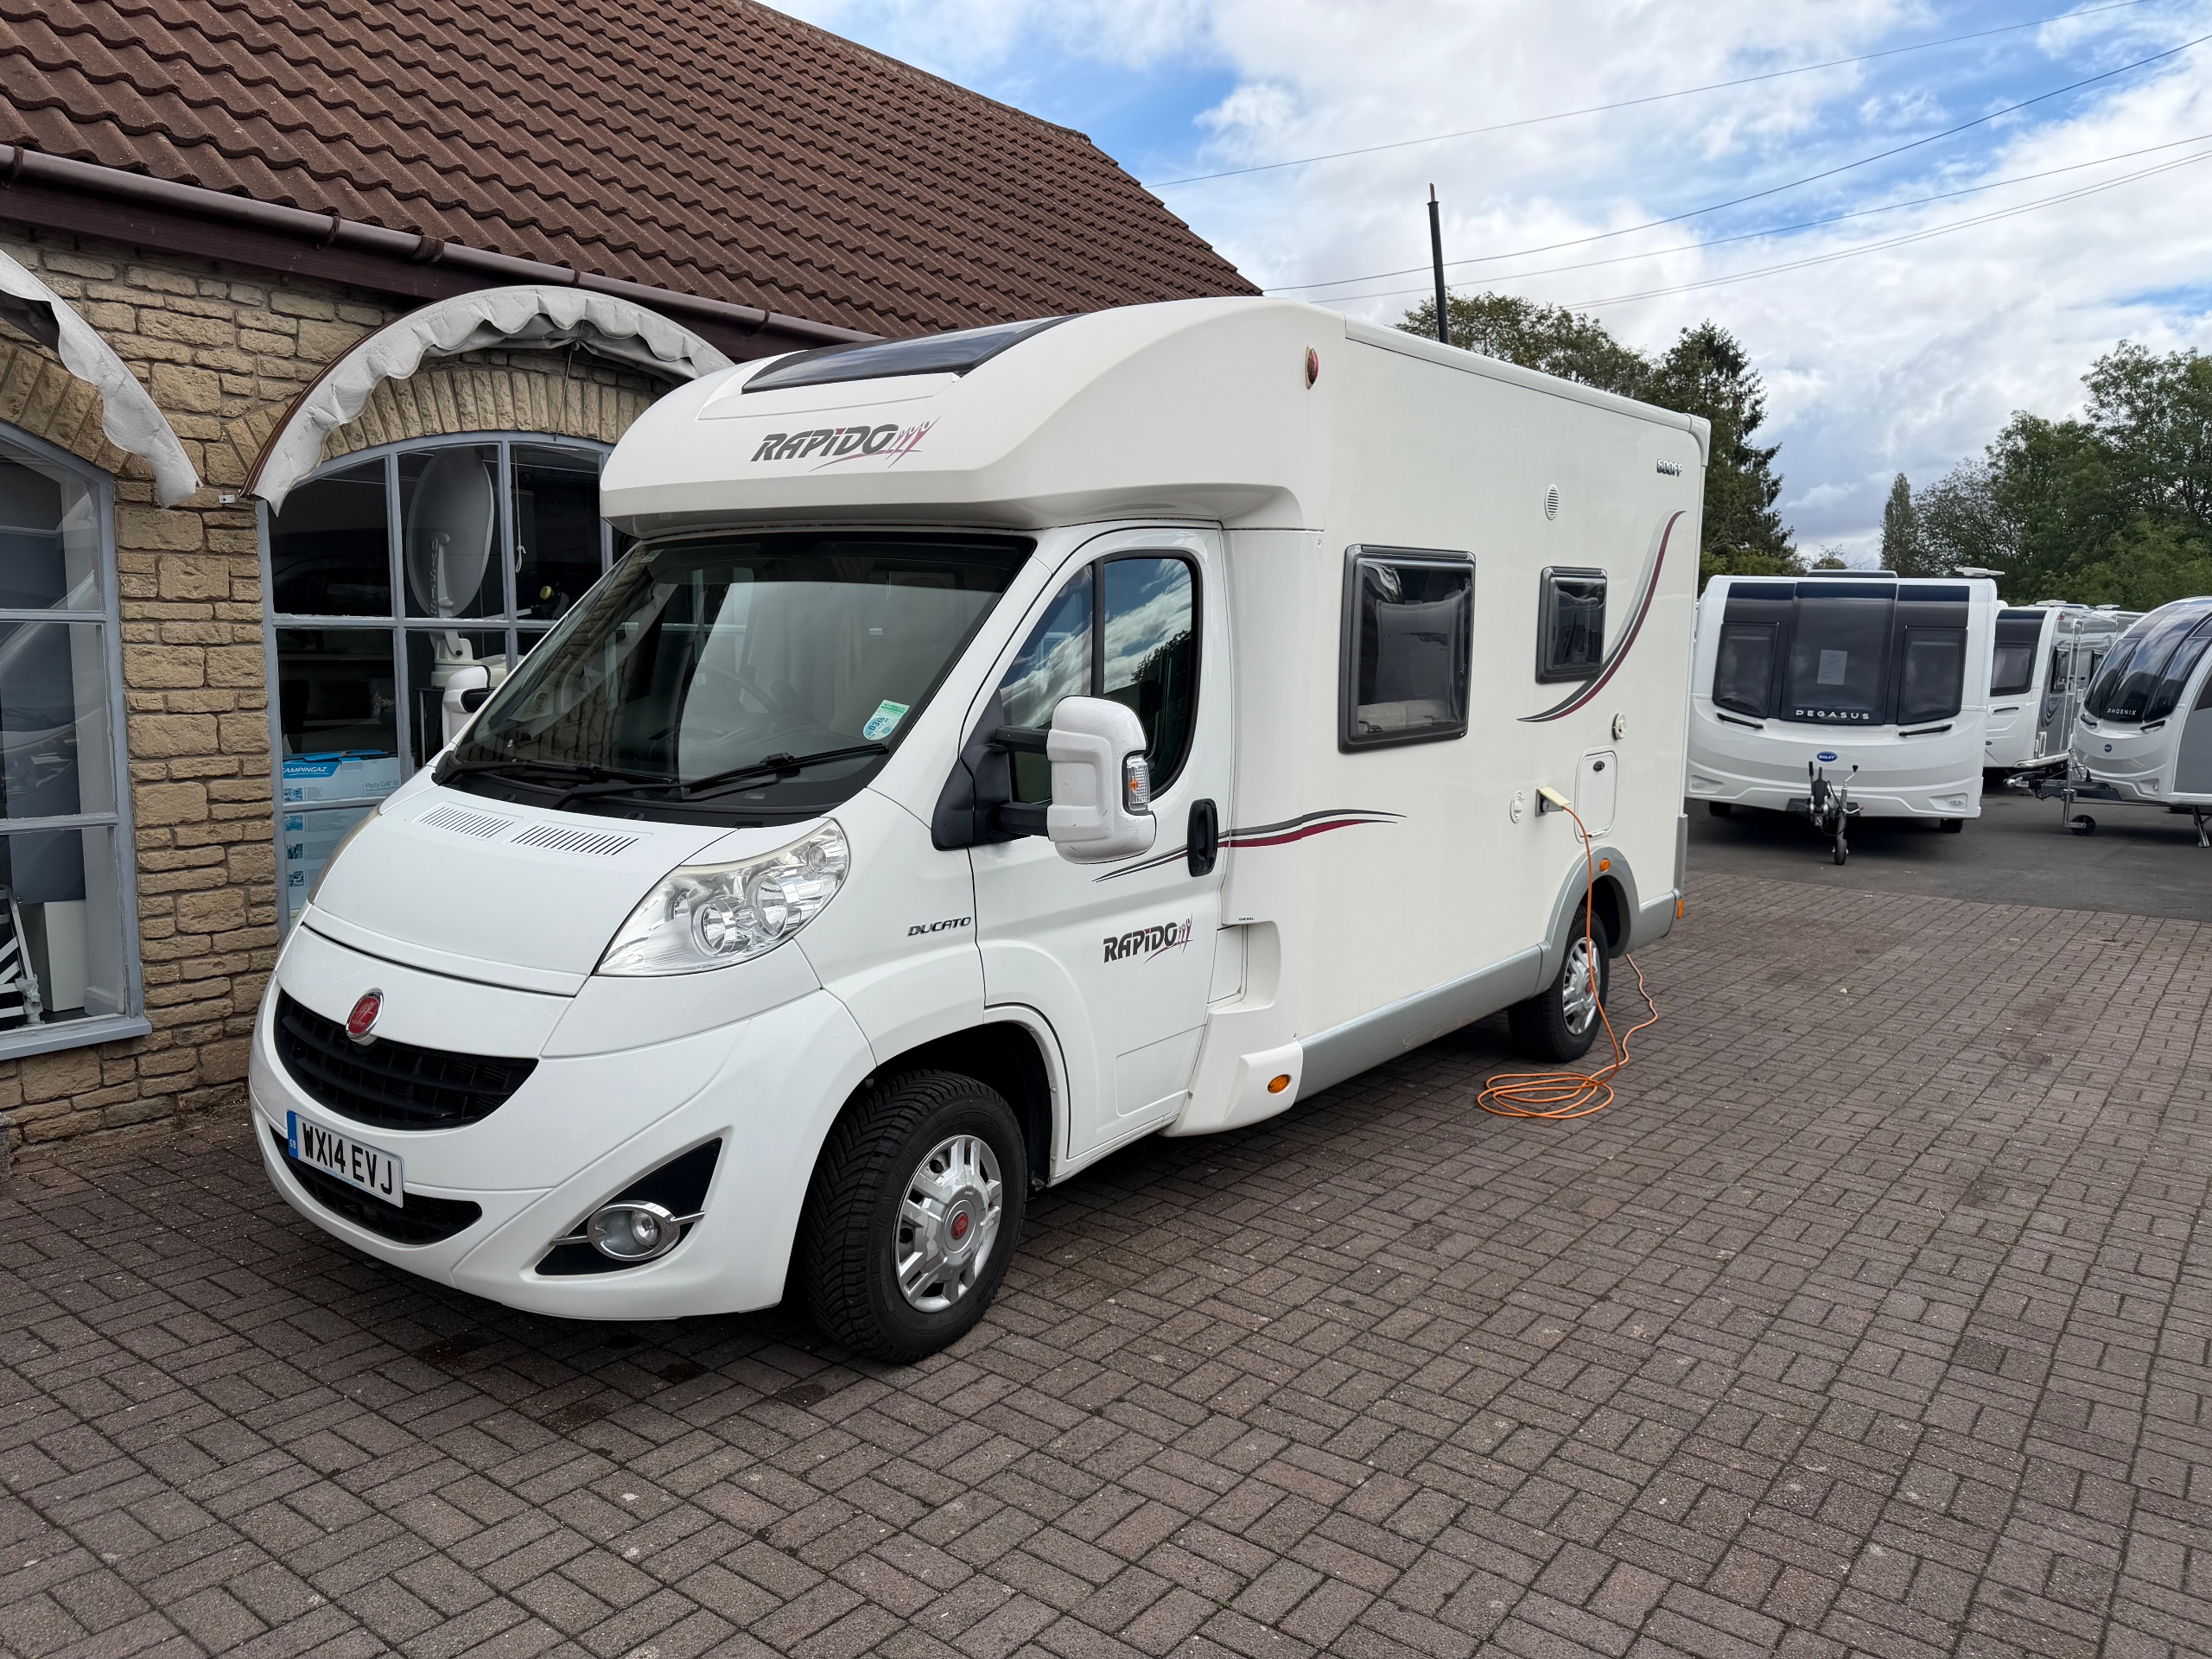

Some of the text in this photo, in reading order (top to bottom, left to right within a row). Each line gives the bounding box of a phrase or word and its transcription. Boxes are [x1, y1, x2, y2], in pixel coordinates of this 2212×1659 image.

[750, 423, 899, 463] RAPIDO
[1796, 709, 1870, 720] PEGASUS
[2107, 708, 2137, 716] PHOENIX
[906, 916, 972, 938] DUCATO
[1103, 921, 1179, 964] RAPIDO
[302, 1122, 392, 1195] WX14 EVJ
